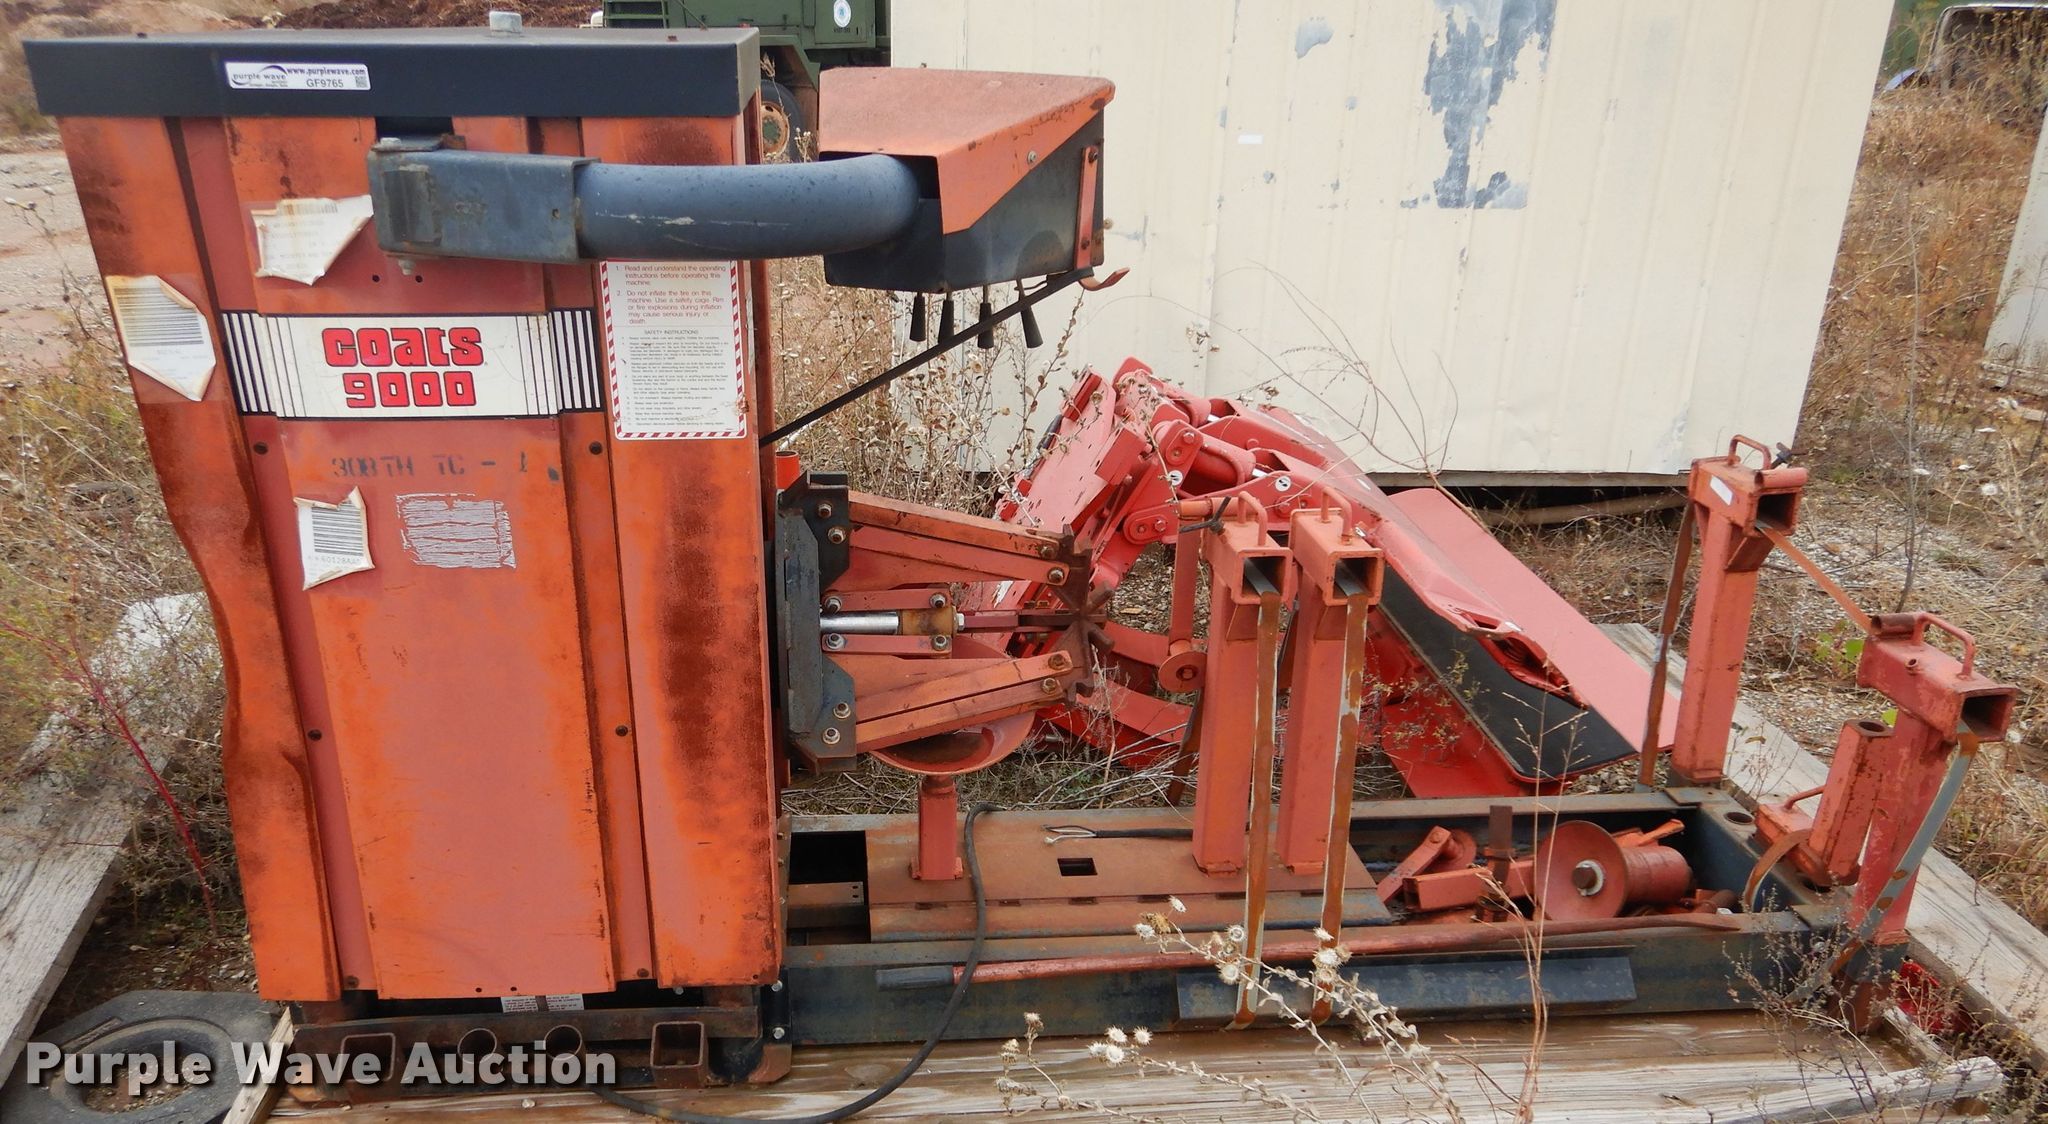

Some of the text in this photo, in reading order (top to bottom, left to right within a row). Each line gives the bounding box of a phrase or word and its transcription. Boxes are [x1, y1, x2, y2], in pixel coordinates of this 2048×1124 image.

[287, 67, 366, 76] www.purplewave.com
[306, 79, 344, 88] GF9765
[342, 371, 477, 408] 9000
